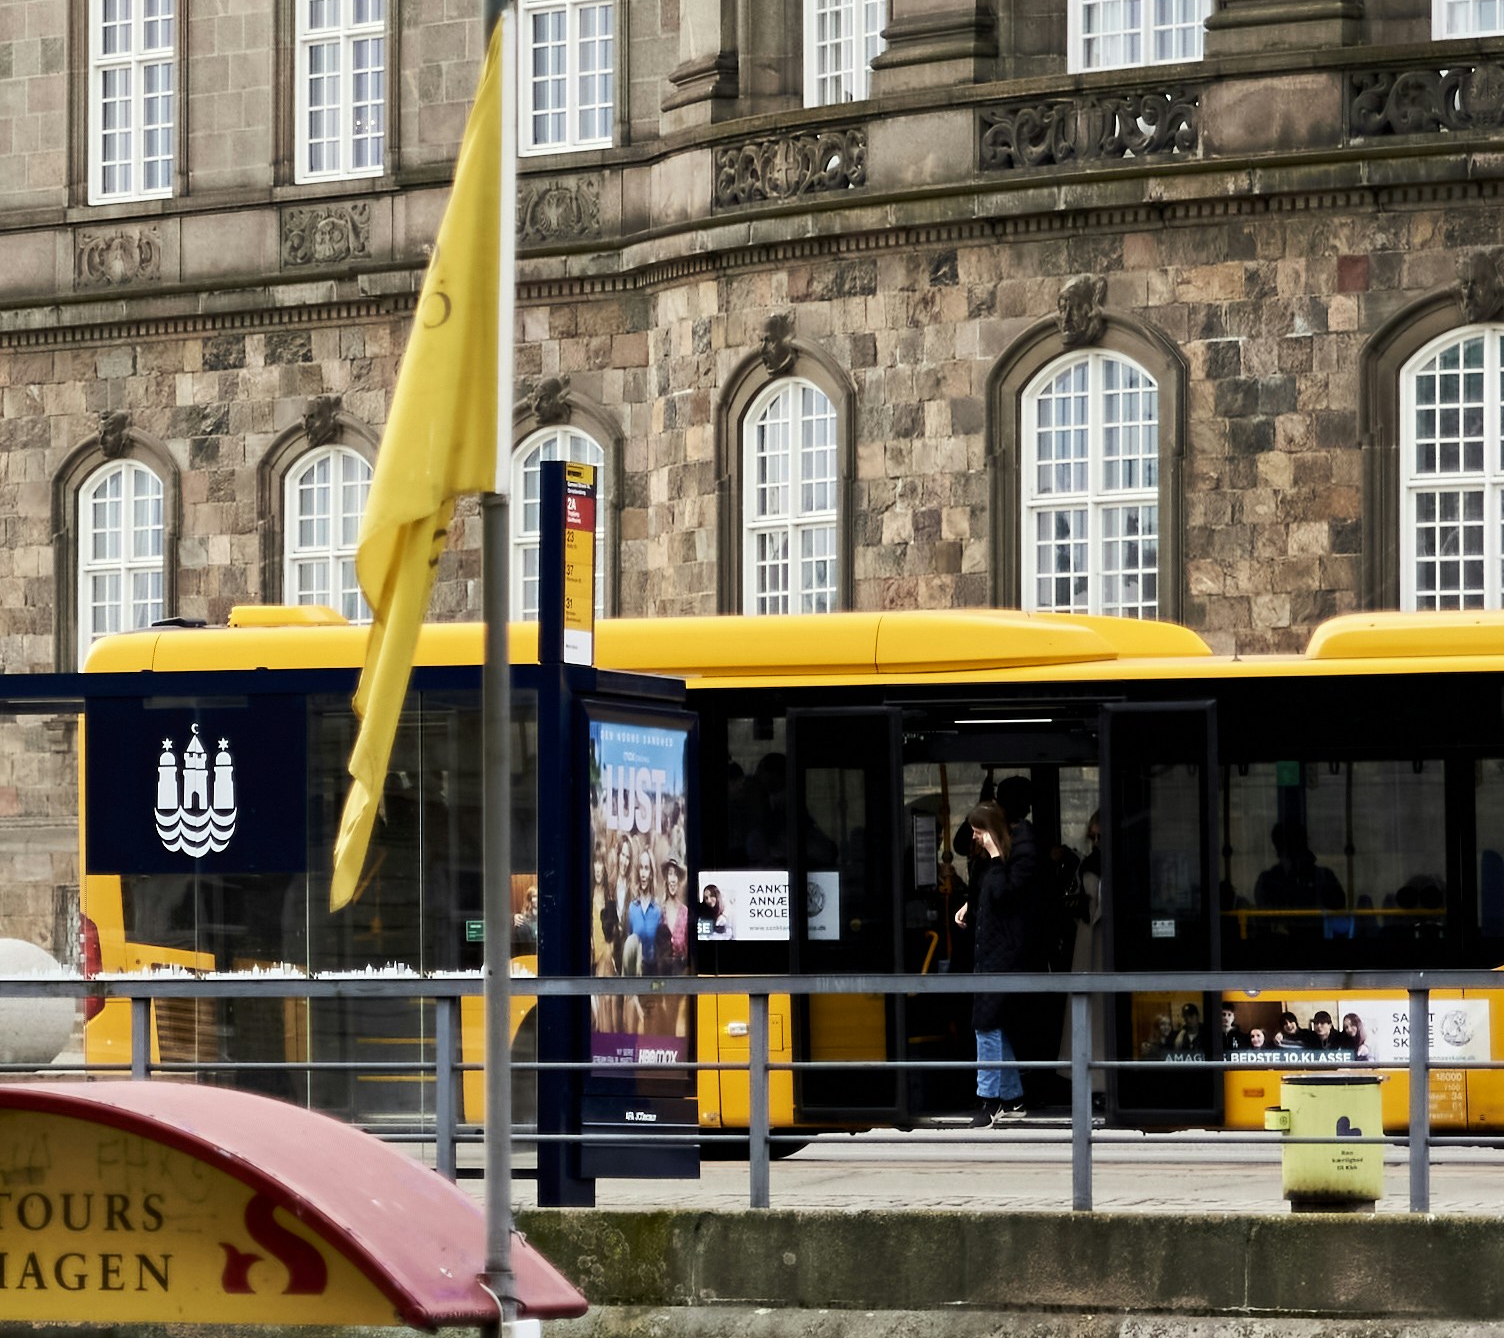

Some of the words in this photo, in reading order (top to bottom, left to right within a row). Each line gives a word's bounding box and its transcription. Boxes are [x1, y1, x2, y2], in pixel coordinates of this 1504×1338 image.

[607, 764, 666, 834] LUST
[749, 884, 789, 894] SANKT
[749, 896, 788, 906] ANNÆ
[749, 908, 788, 918] SKOLE
